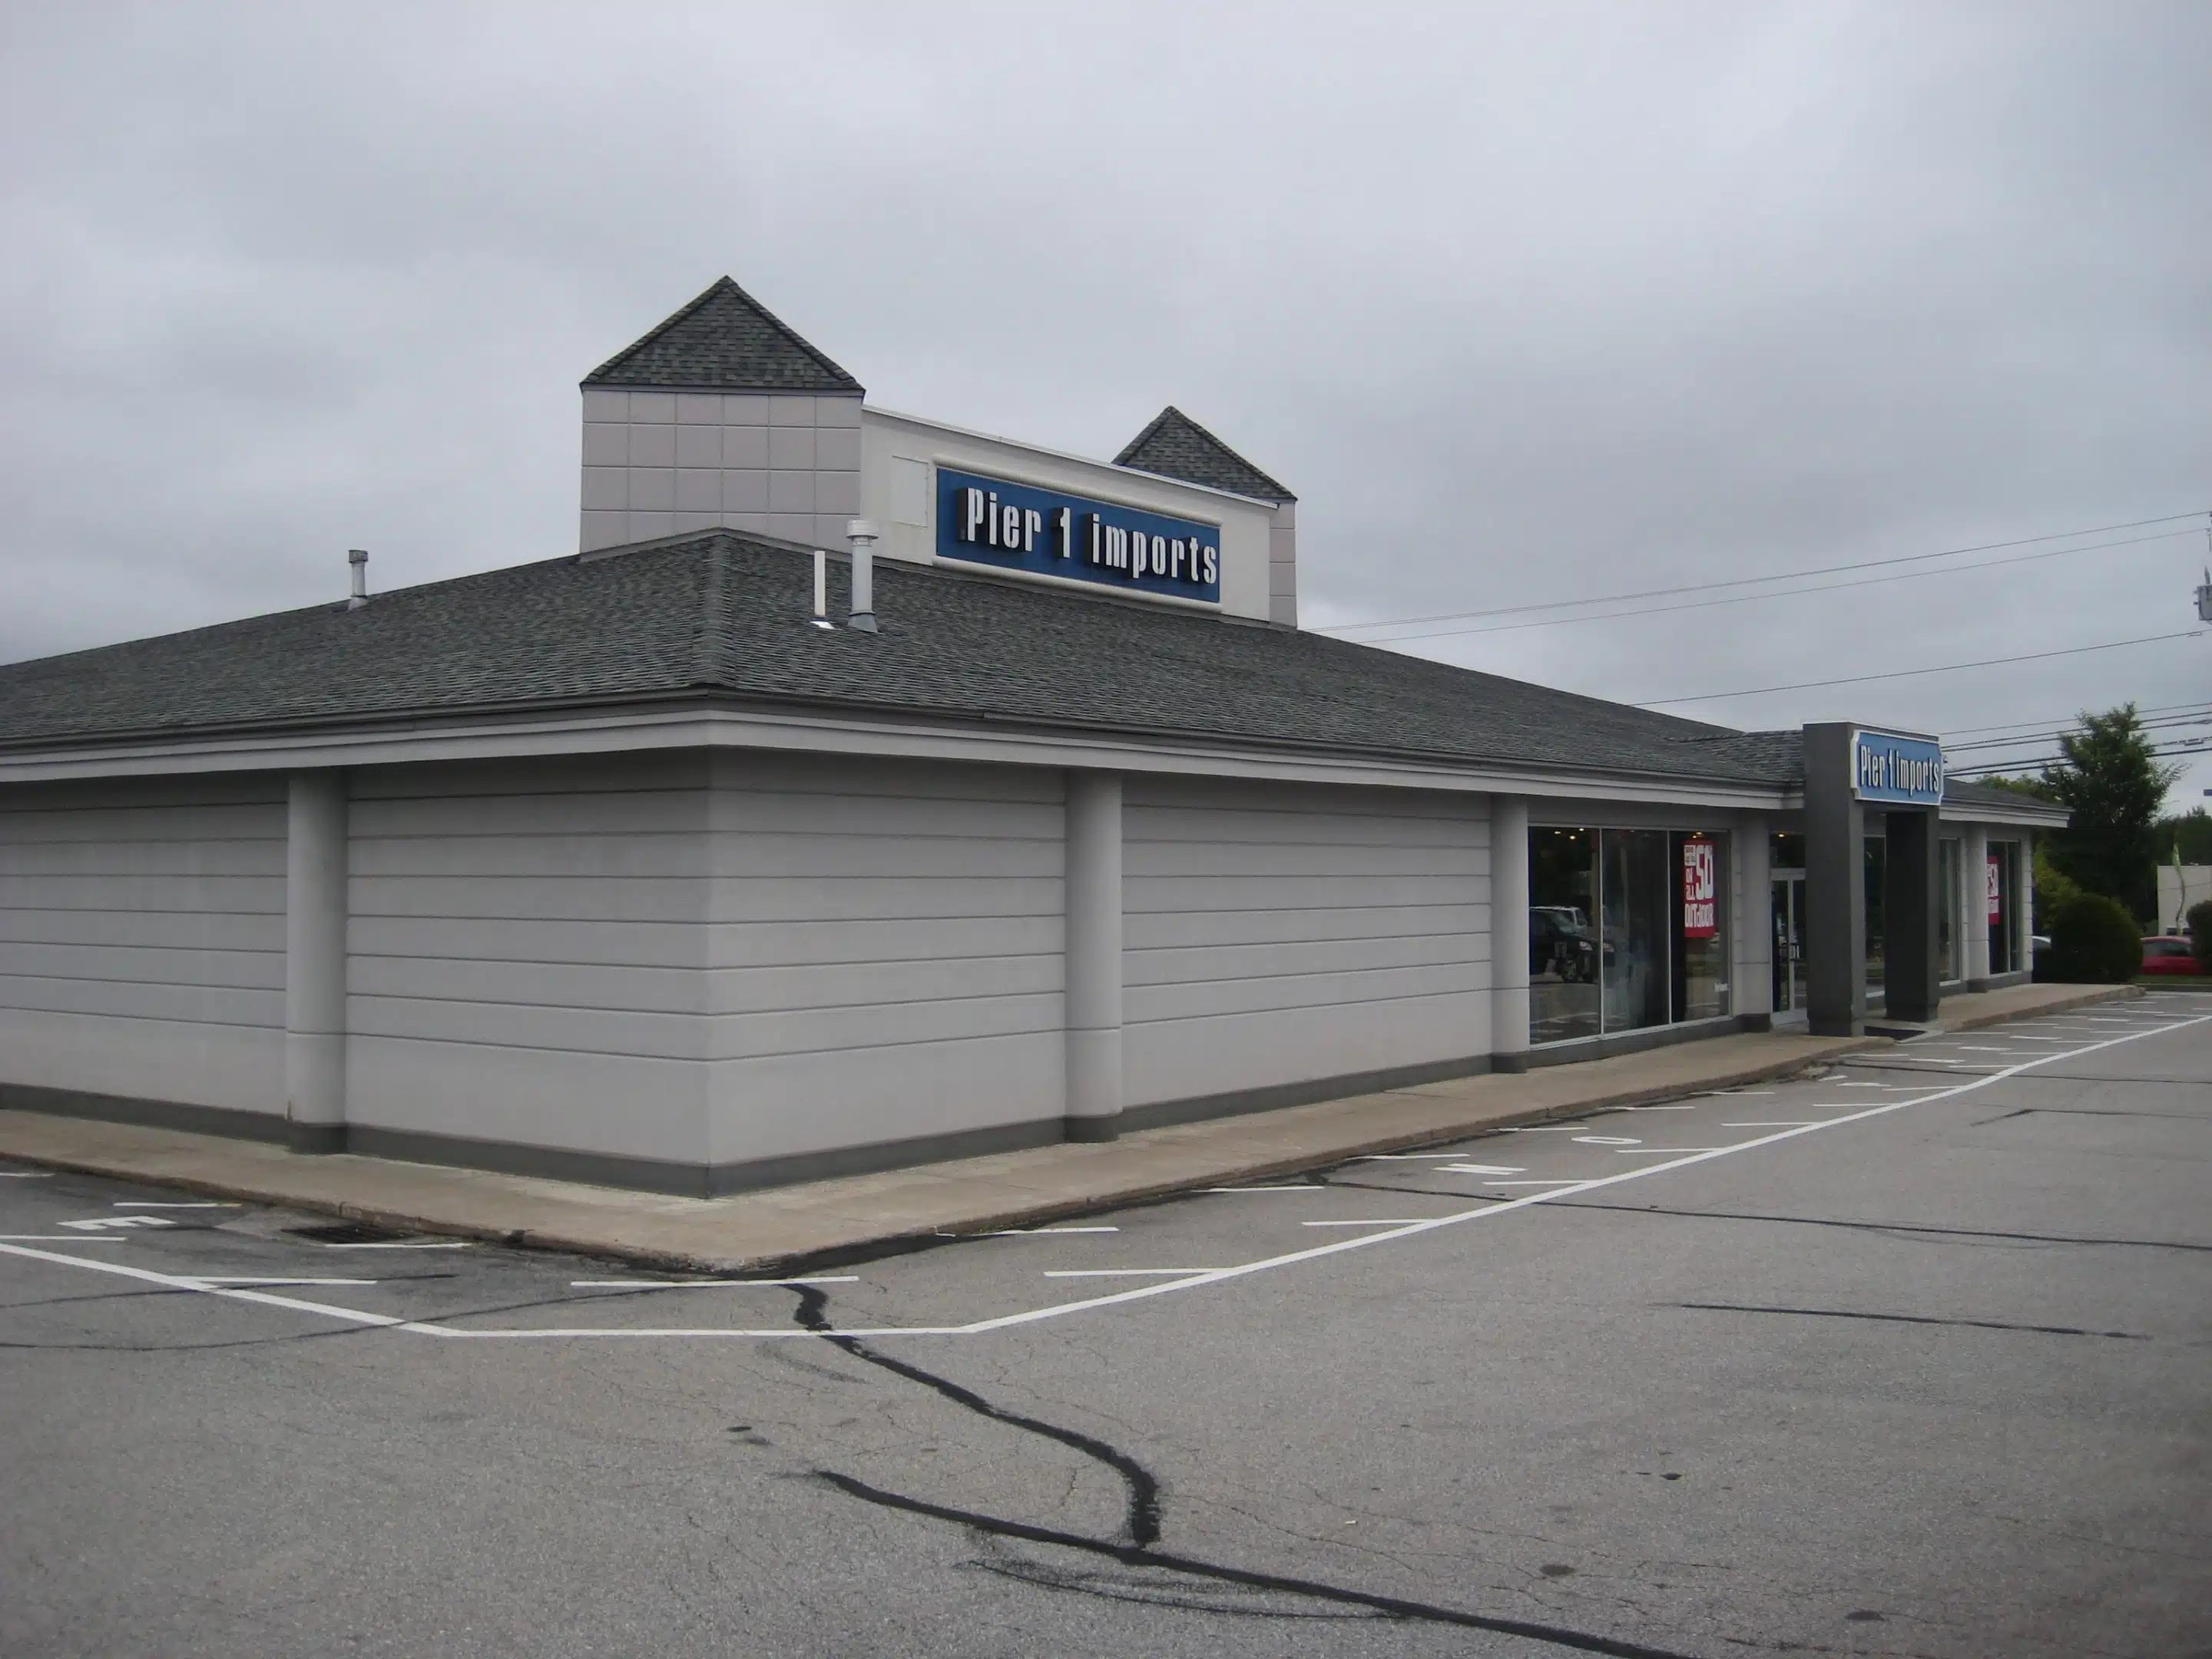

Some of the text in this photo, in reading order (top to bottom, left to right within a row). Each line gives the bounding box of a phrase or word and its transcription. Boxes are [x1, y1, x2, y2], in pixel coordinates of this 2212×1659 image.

[965, 487, 1217, 584] Pier 1 imports
[1859, 744, 1885, 787] Pier
[1889, 748, 1893, 788] 1
